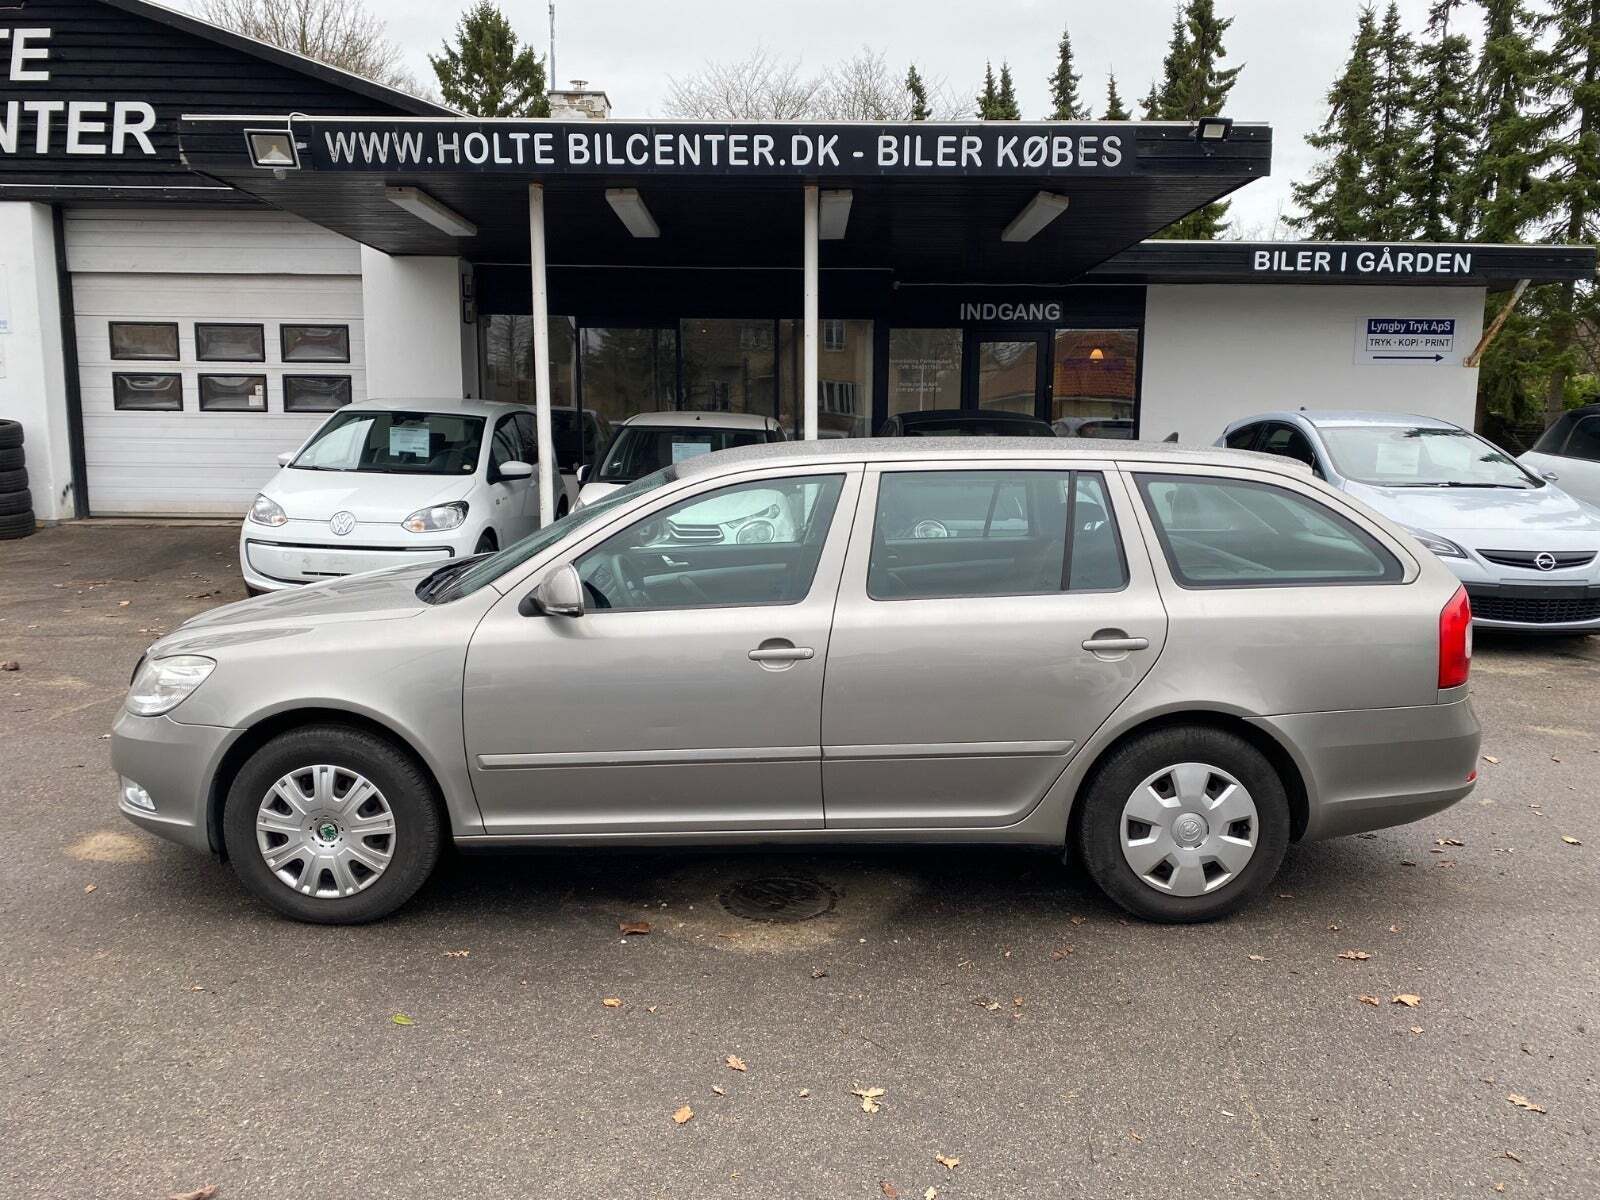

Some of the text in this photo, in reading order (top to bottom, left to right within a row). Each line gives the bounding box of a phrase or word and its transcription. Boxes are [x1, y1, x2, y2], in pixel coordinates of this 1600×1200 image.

[0, 28, 51, 80] E
[324, 131, 555, 164] WWW.HOLTE
[568, 132, 840, 167] BILCENTER.DK
[877, 134, 983, 168] BILER
[997, 135, 1122, 168] KØBES
[1254, 247, 1472, 274] BILER I GÅRDEN
[960, 303, 1061, 321] INDGANG
[1371, 321, 1451, 333] Lyngby Tryk ApS
[1370, 338, 1392, 347] TRYK
[1398, 338, 1419, 347] KOPI
[1425, 338, 1451, 347] PRINT
